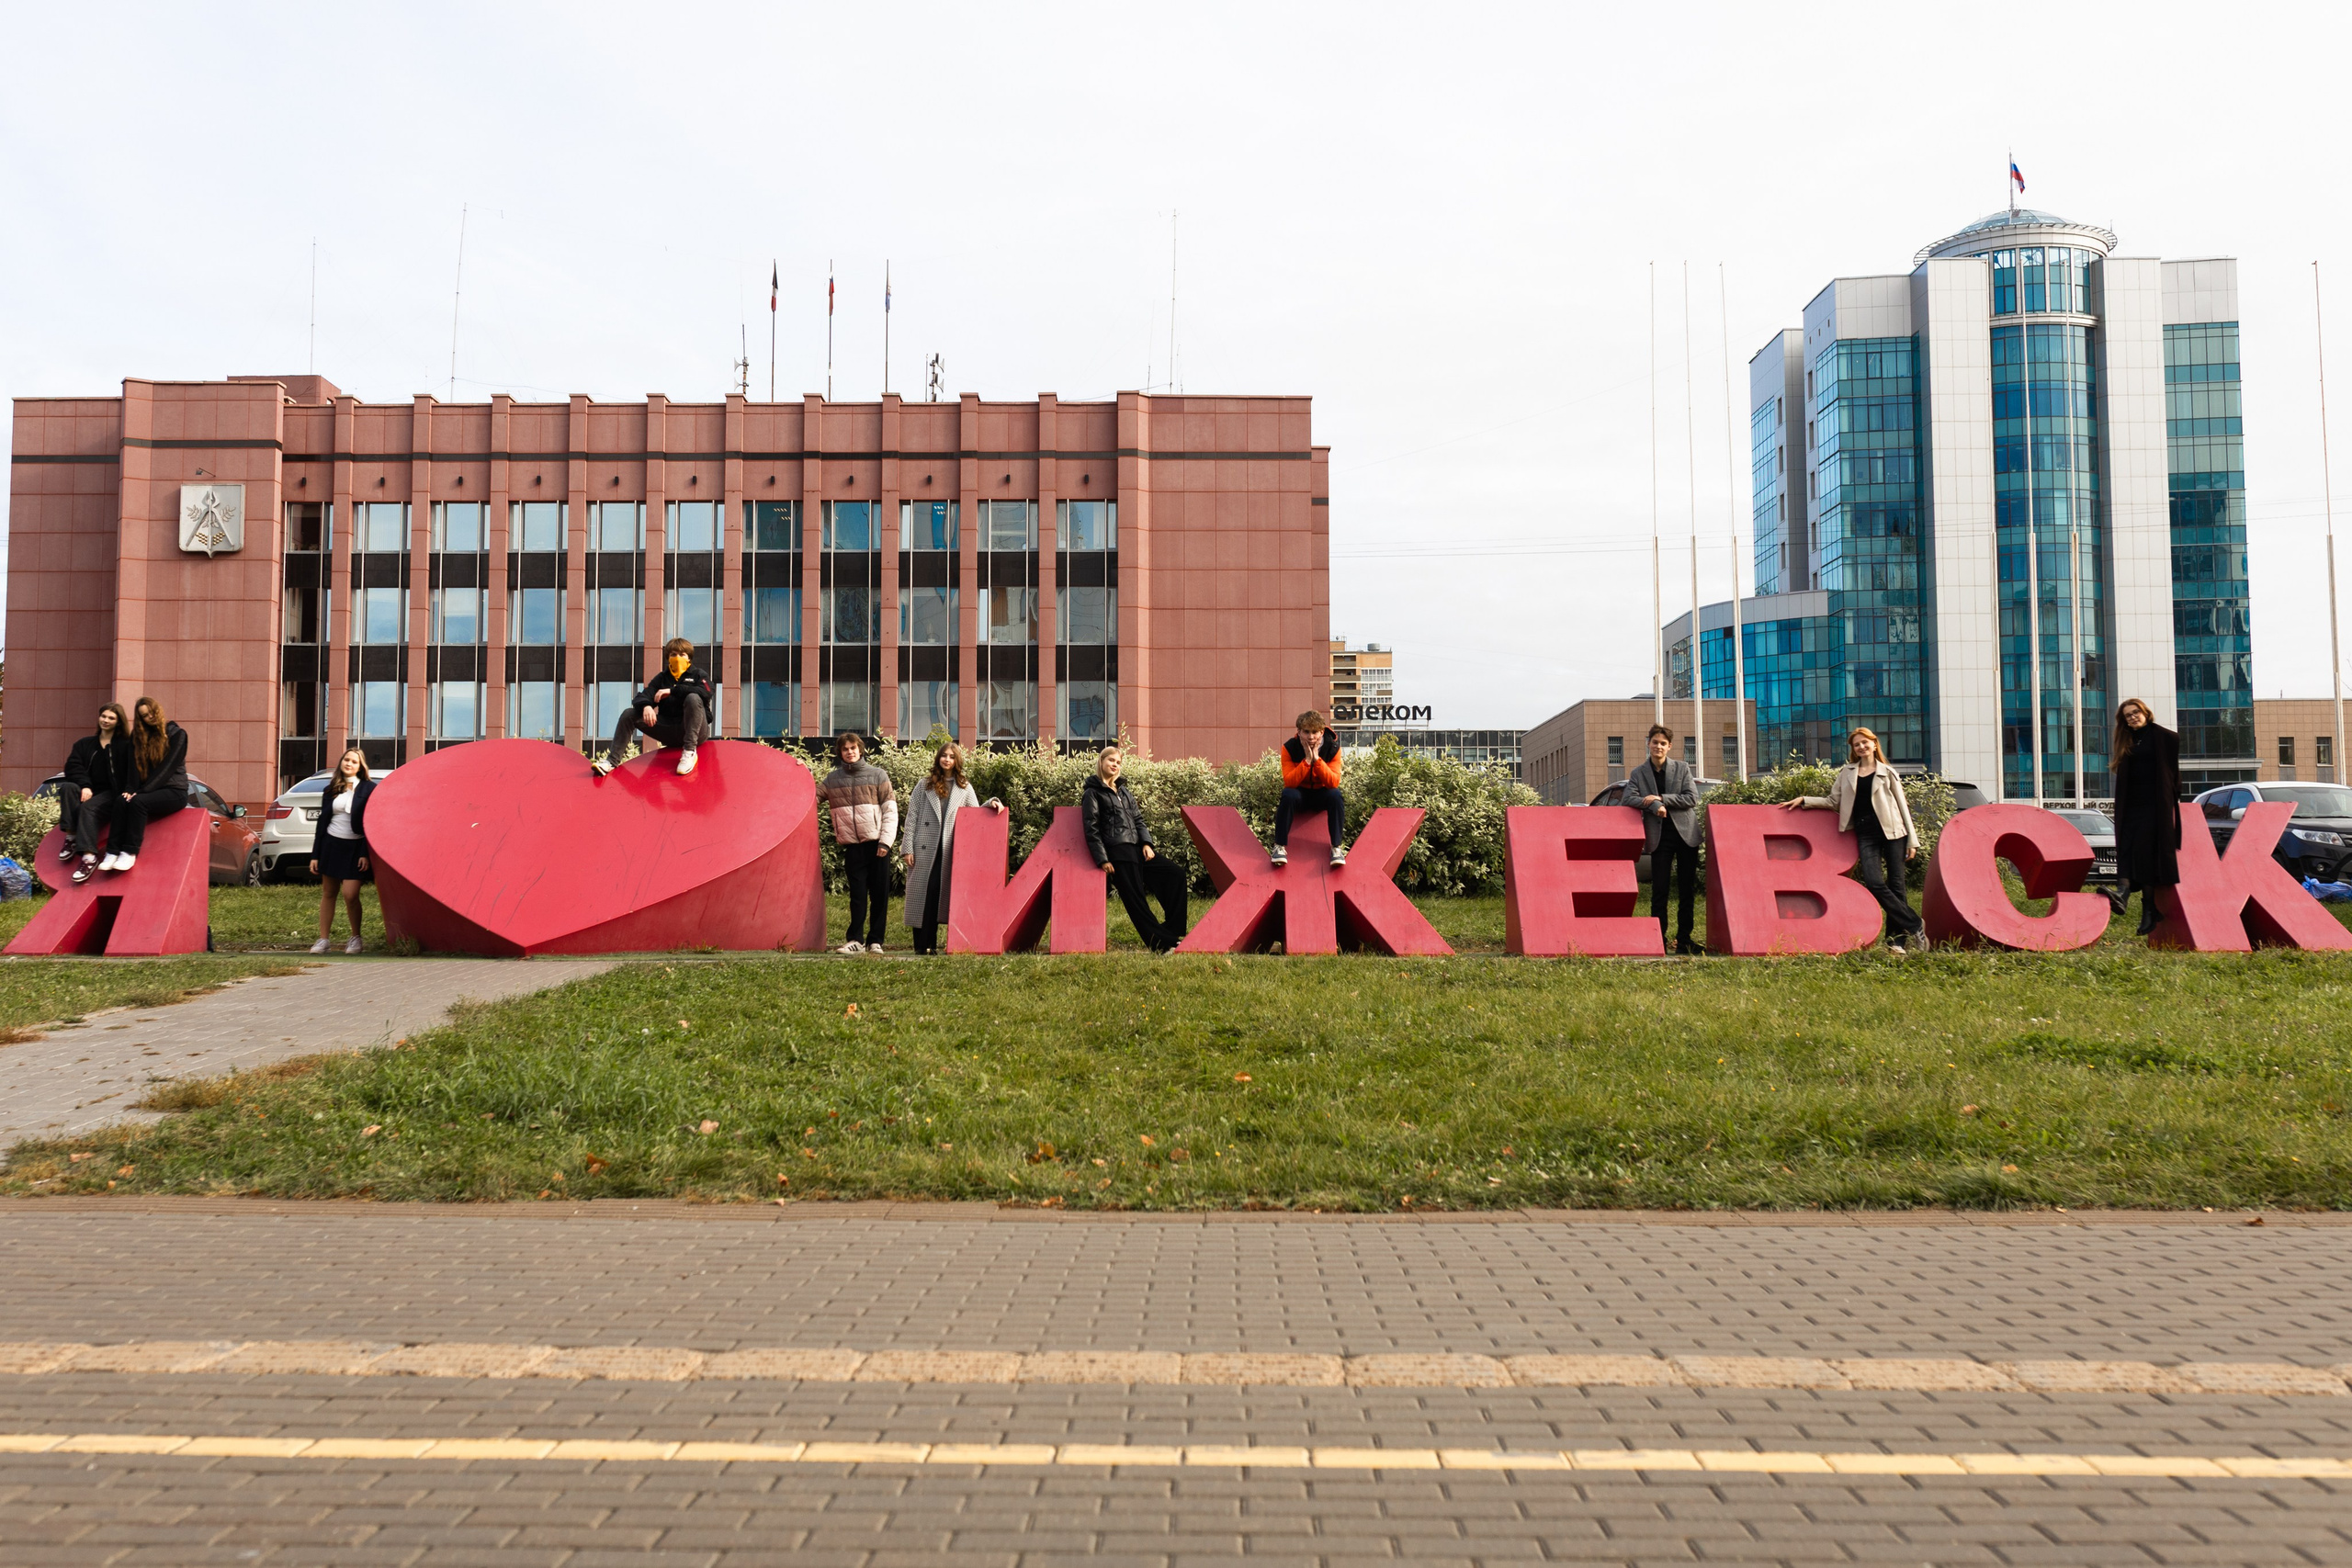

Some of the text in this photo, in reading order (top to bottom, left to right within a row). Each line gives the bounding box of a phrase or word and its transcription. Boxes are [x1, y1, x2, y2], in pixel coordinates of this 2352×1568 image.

[1330, 705, 1431, 720] елеком
[2042, 801, 2116, 809] ВЕРХОВЫЙ СУД
[1, 802, 2352, 956] Я ИЖЕВСК
